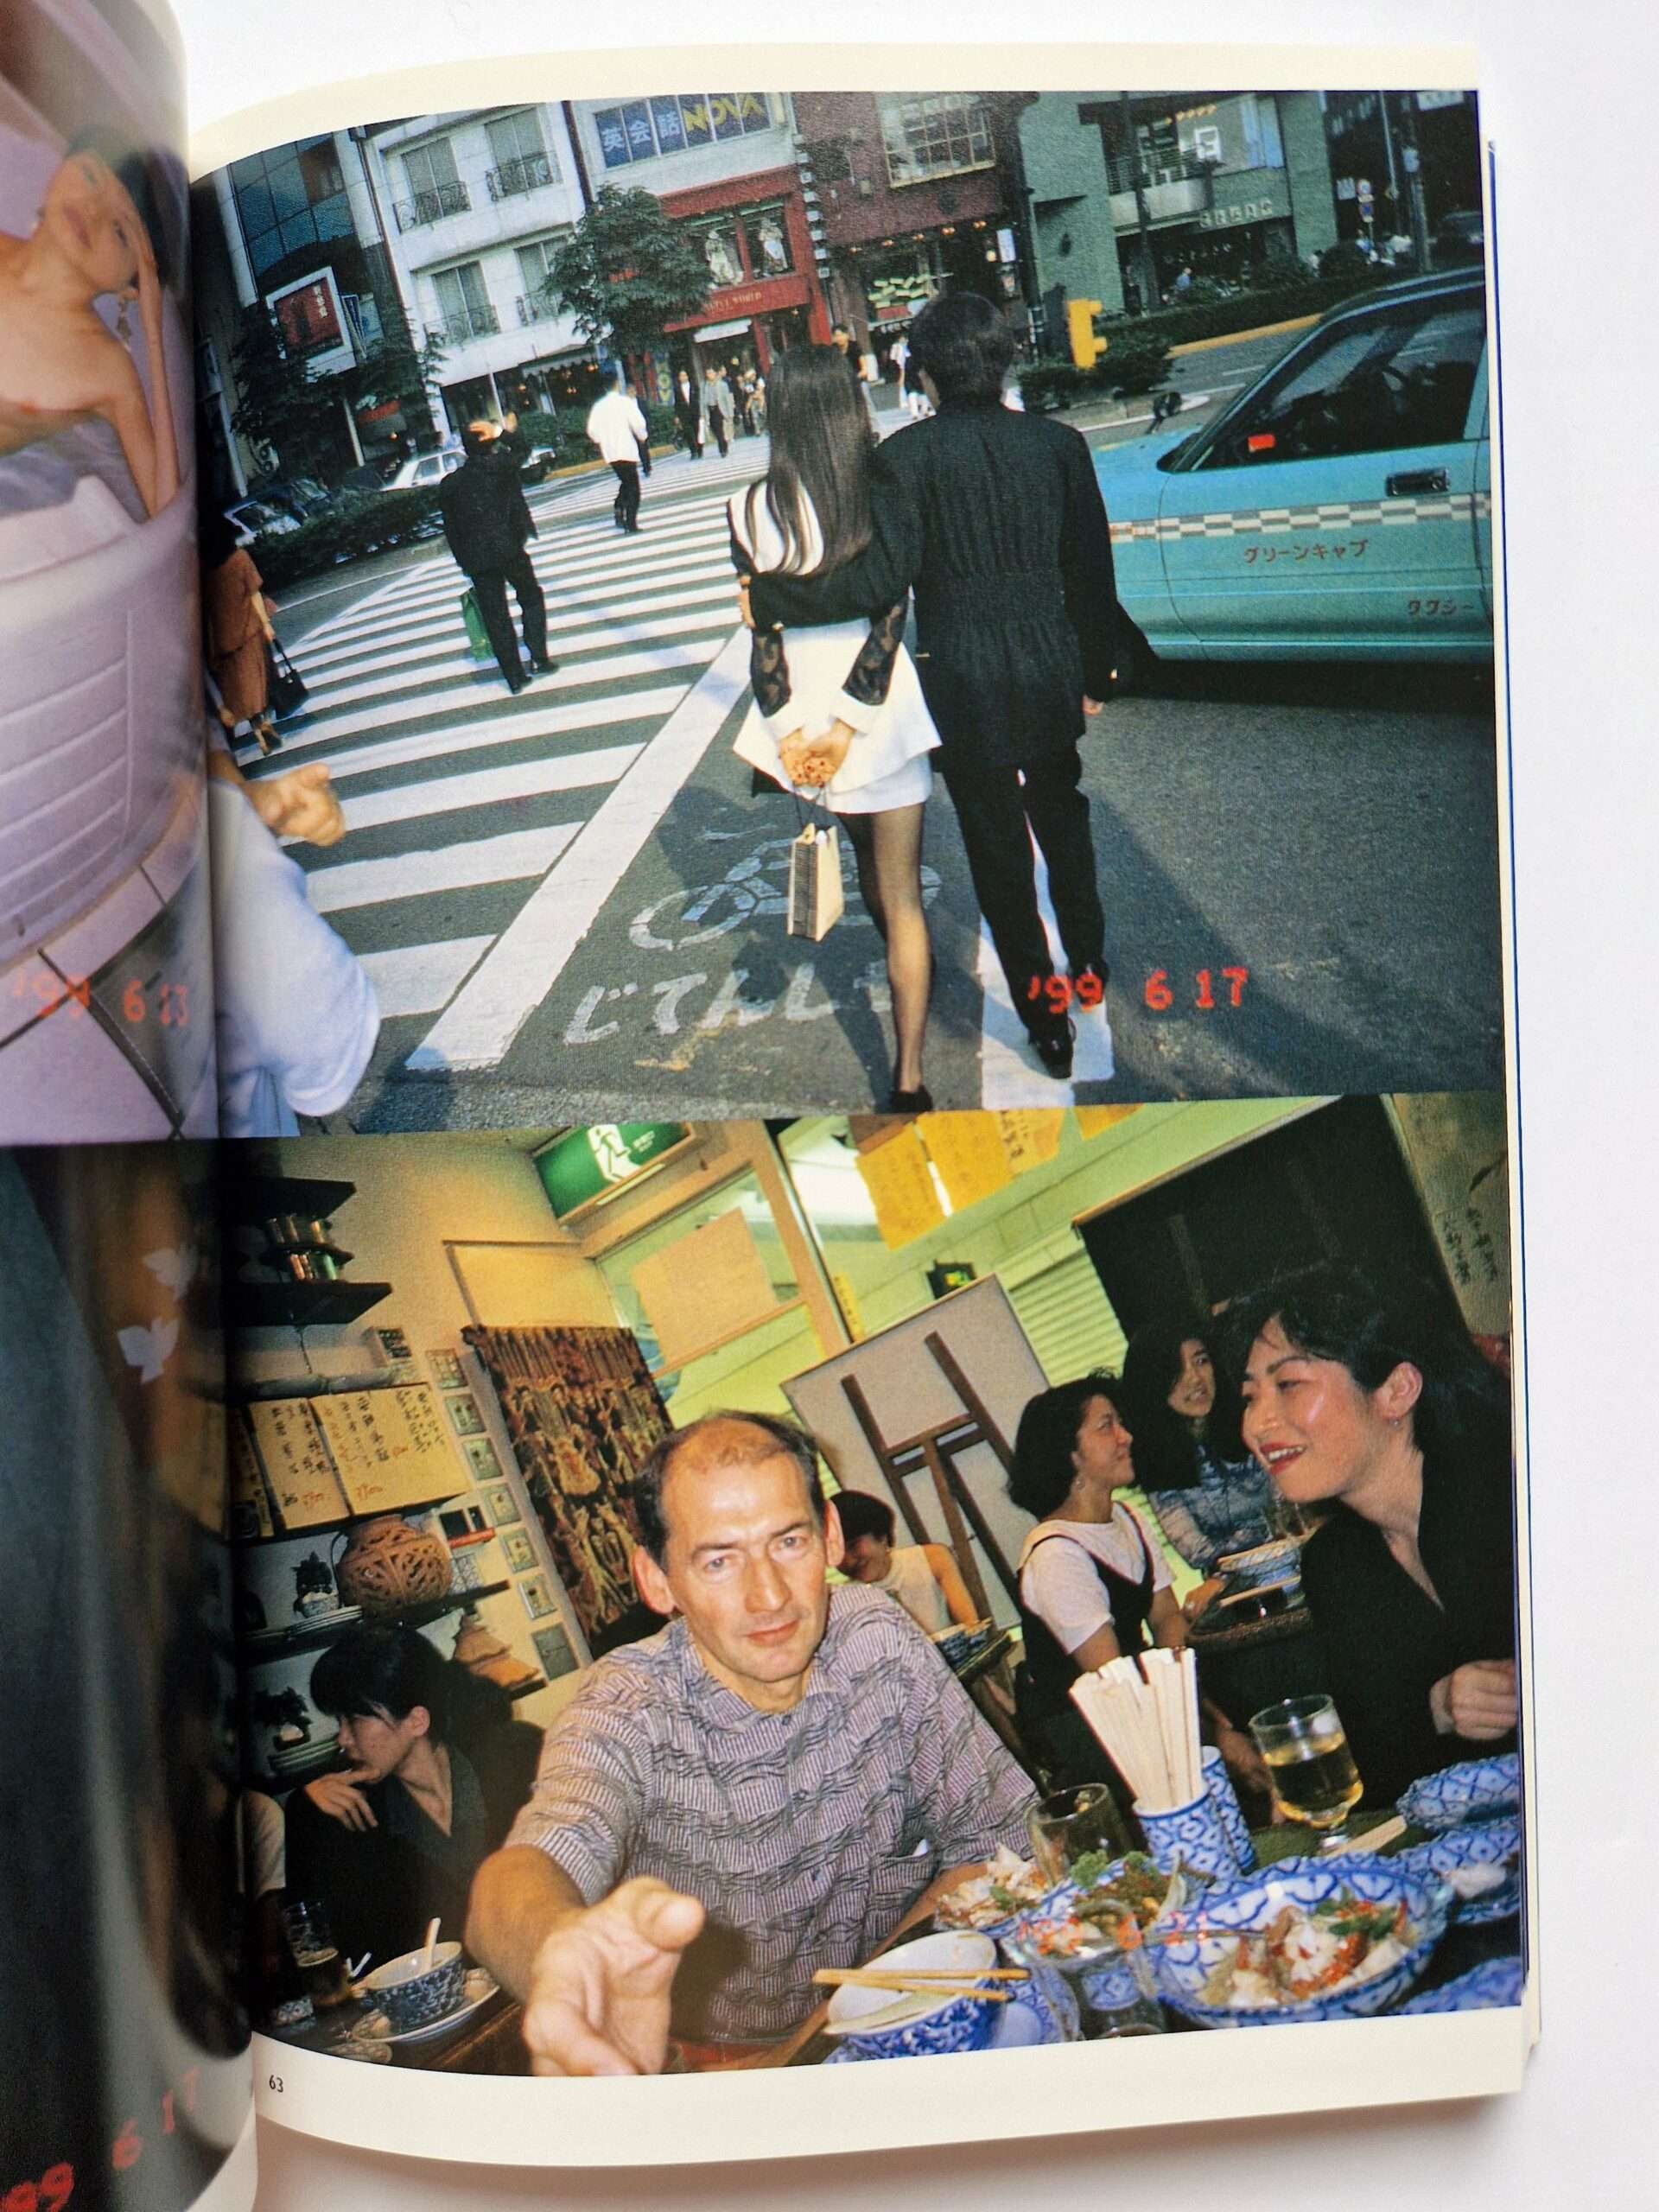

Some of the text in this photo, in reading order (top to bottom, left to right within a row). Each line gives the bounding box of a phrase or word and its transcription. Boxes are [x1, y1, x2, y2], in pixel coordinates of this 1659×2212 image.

[602, 93, 766, 153] 英会話 NOVA
[1243, 539, 1369, 563] グリーンキャブ
[269, 2075, 284, 2093] 63
